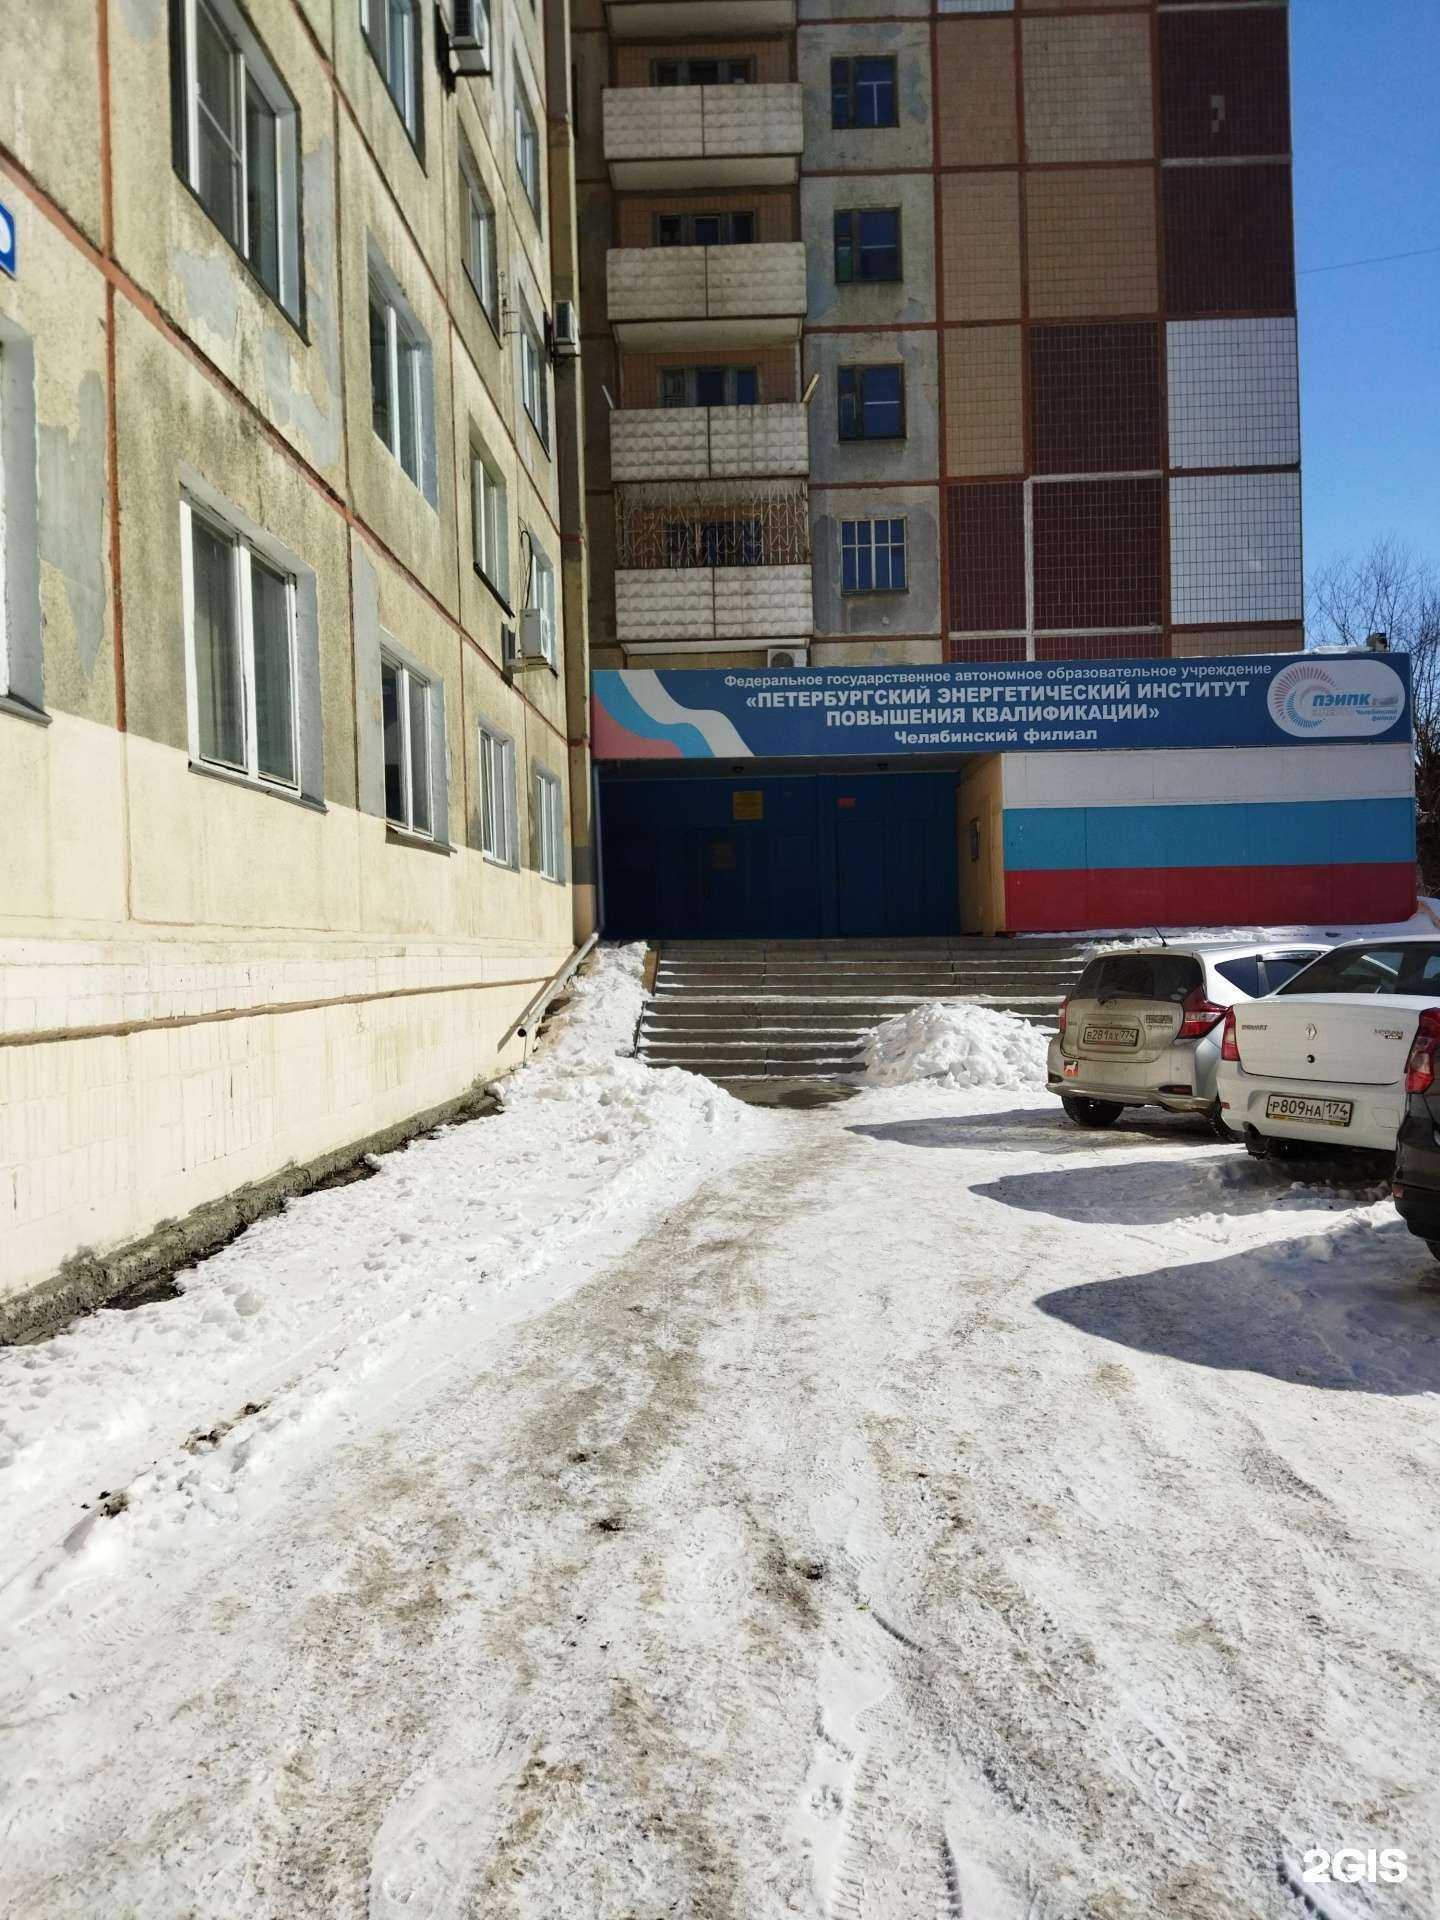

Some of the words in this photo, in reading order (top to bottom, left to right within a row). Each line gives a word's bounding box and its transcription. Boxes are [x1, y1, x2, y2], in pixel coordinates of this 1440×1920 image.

[724, 675, 823, 688] Федеральное
[827, 671, 951, 687] государственное
[955, 669, 1043, 682] автономное
[1047, 666, 1177, 681] образовательное
[1181, 664, 1272, 679] учреждение
[746, 685, 931, 708] «ПЕТЕРБУРГСКИЙ
[937, 681, 1134, 703] ЭНЕРГЕТИЧЕСКИЙ
[1137, 681, 1249, 699] ИНСТИТУТ
[1312, 694, 1371, 706] ПЭИПК
[826, 708, 965, 727] ПОВЫШЕНИЯ
[972, 703, 1160, 723] КВАЛИФИКАЦИИ»
[894, 728, 1018, 745] Челябинский
[1024, 728, 1098, 743] филиал
